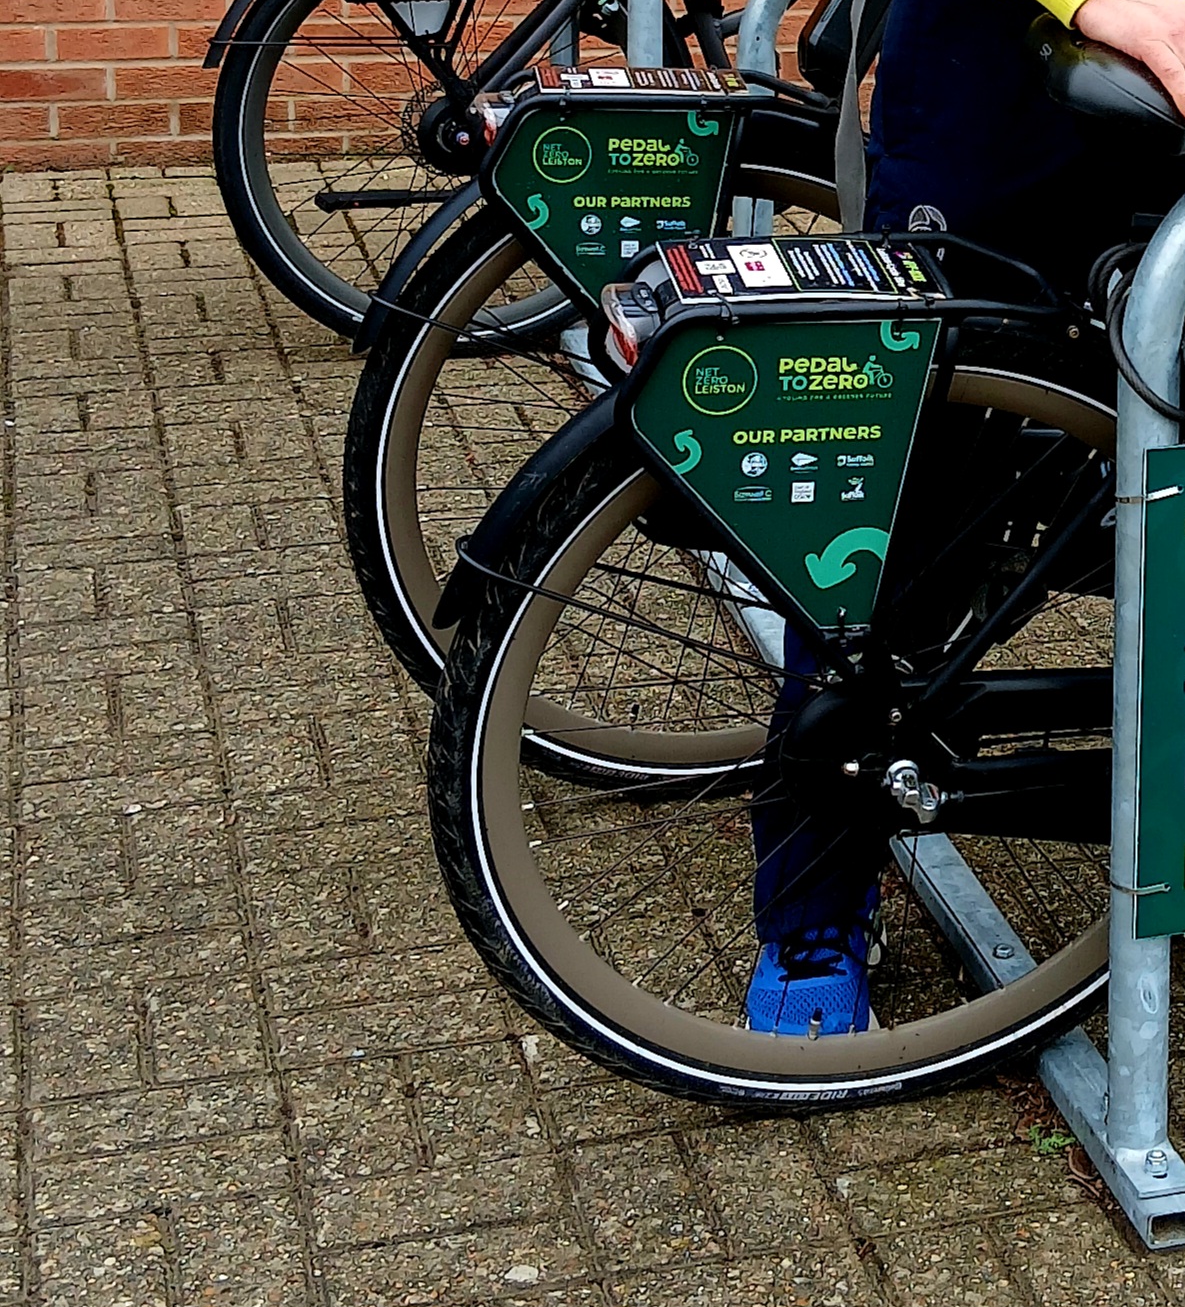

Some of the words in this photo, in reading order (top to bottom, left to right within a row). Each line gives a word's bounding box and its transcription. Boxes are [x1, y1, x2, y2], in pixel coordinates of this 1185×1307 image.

[573, 196, 607, 208] OUR
[695, 367, 720, 376] NET
[695, 376, 728, 385] ZERO
[695, 383, 746, 395] LEISTON
[733, 430, 775, 444] OUR
